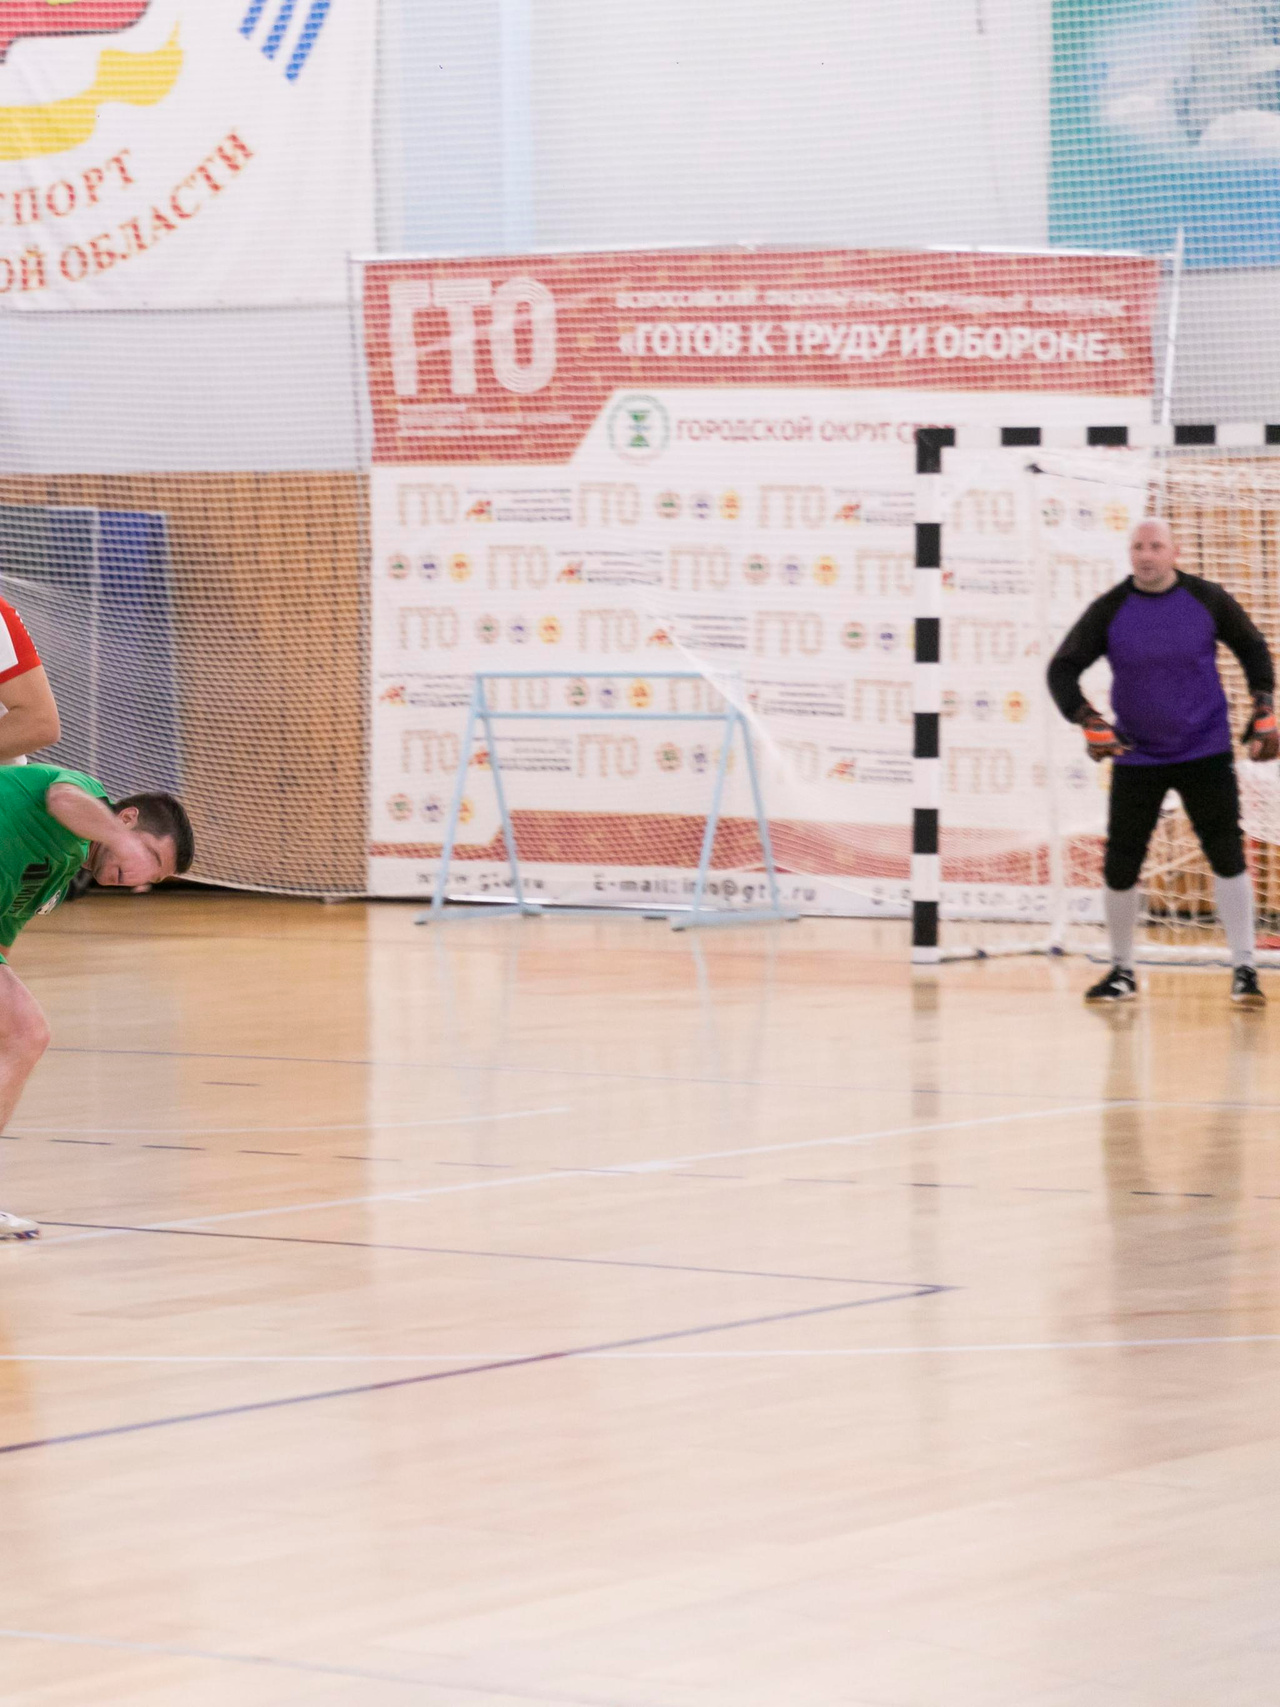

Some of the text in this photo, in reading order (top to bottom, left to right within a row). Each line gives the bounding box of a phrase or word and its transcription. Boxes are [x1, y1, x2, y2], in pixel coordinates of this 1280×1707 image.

[60, 128, 256, 283] ОБЛАСТИ
[388, 277, 557, 396] ГТО
[749, 323, 779, 356] К
[785, 323, 894, 361] ТРУДУ
[900, 324, 928, 357] И
[676, 416, 814, 442] ГОРОДСКОЙ
[819, 420, 890, 443] ОКРУГ
